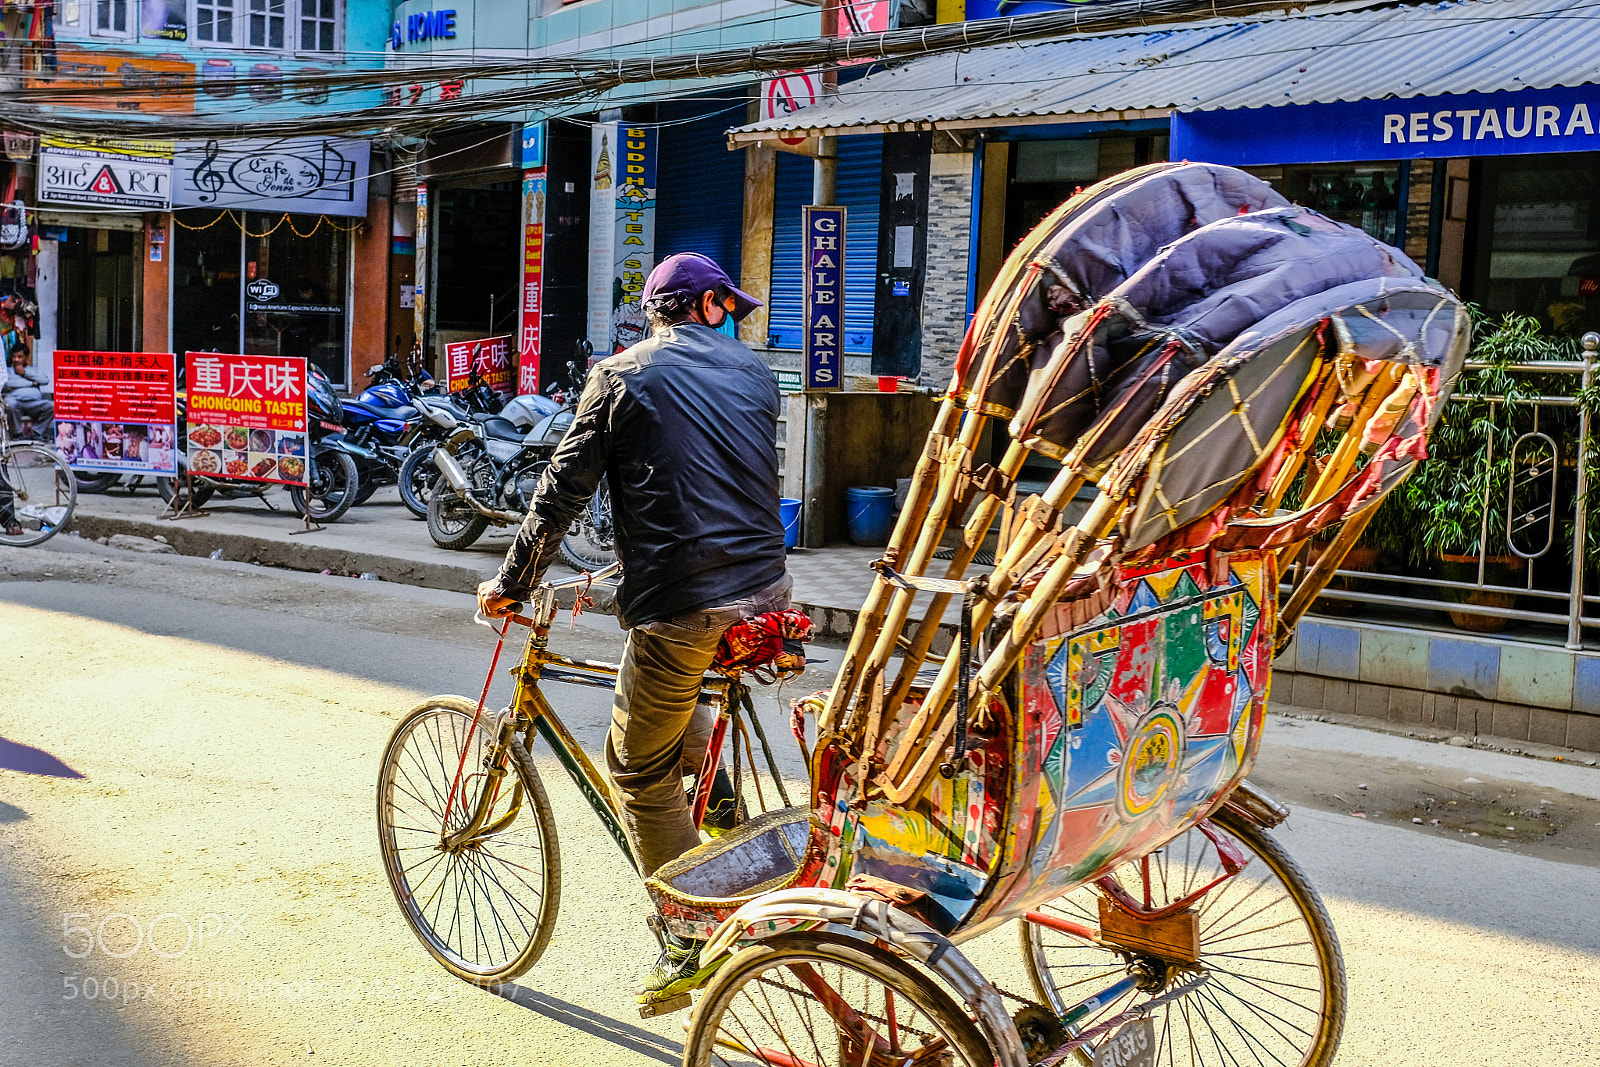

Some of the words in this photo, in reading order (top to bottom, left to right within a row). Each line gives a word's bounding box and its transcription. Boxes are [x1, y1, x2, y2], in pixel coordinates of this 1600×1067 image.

[174, 30, 186, 40] Trip
[408, 9, 456, 42] HOME
[1383, 103, 1600, 144] RESTAURA
[248, 158, 288, 181] Cafe
[283, 174, 294, 185] de
[626, 128, 646, 198] BUDDHA
[526, 237, 541, 246] Lhasa
[623, 212, 644, 246] TEA
[525, 264, 541, 273] House
[526, 250, 541, 260] Guest
[814, 218, 837, 305] GHALE
[622, 260, 642, 304] SHOP
[521, 282, 540, 394] 重庆味
[814, 315, 835, 382] ARTS
[192, 357, 301, 399] 重庆味
[491, 370, 511, 384] TASTE
[190, 395, 262, 413] CHONGQING
[264, 400, 304, 416] TASTE
